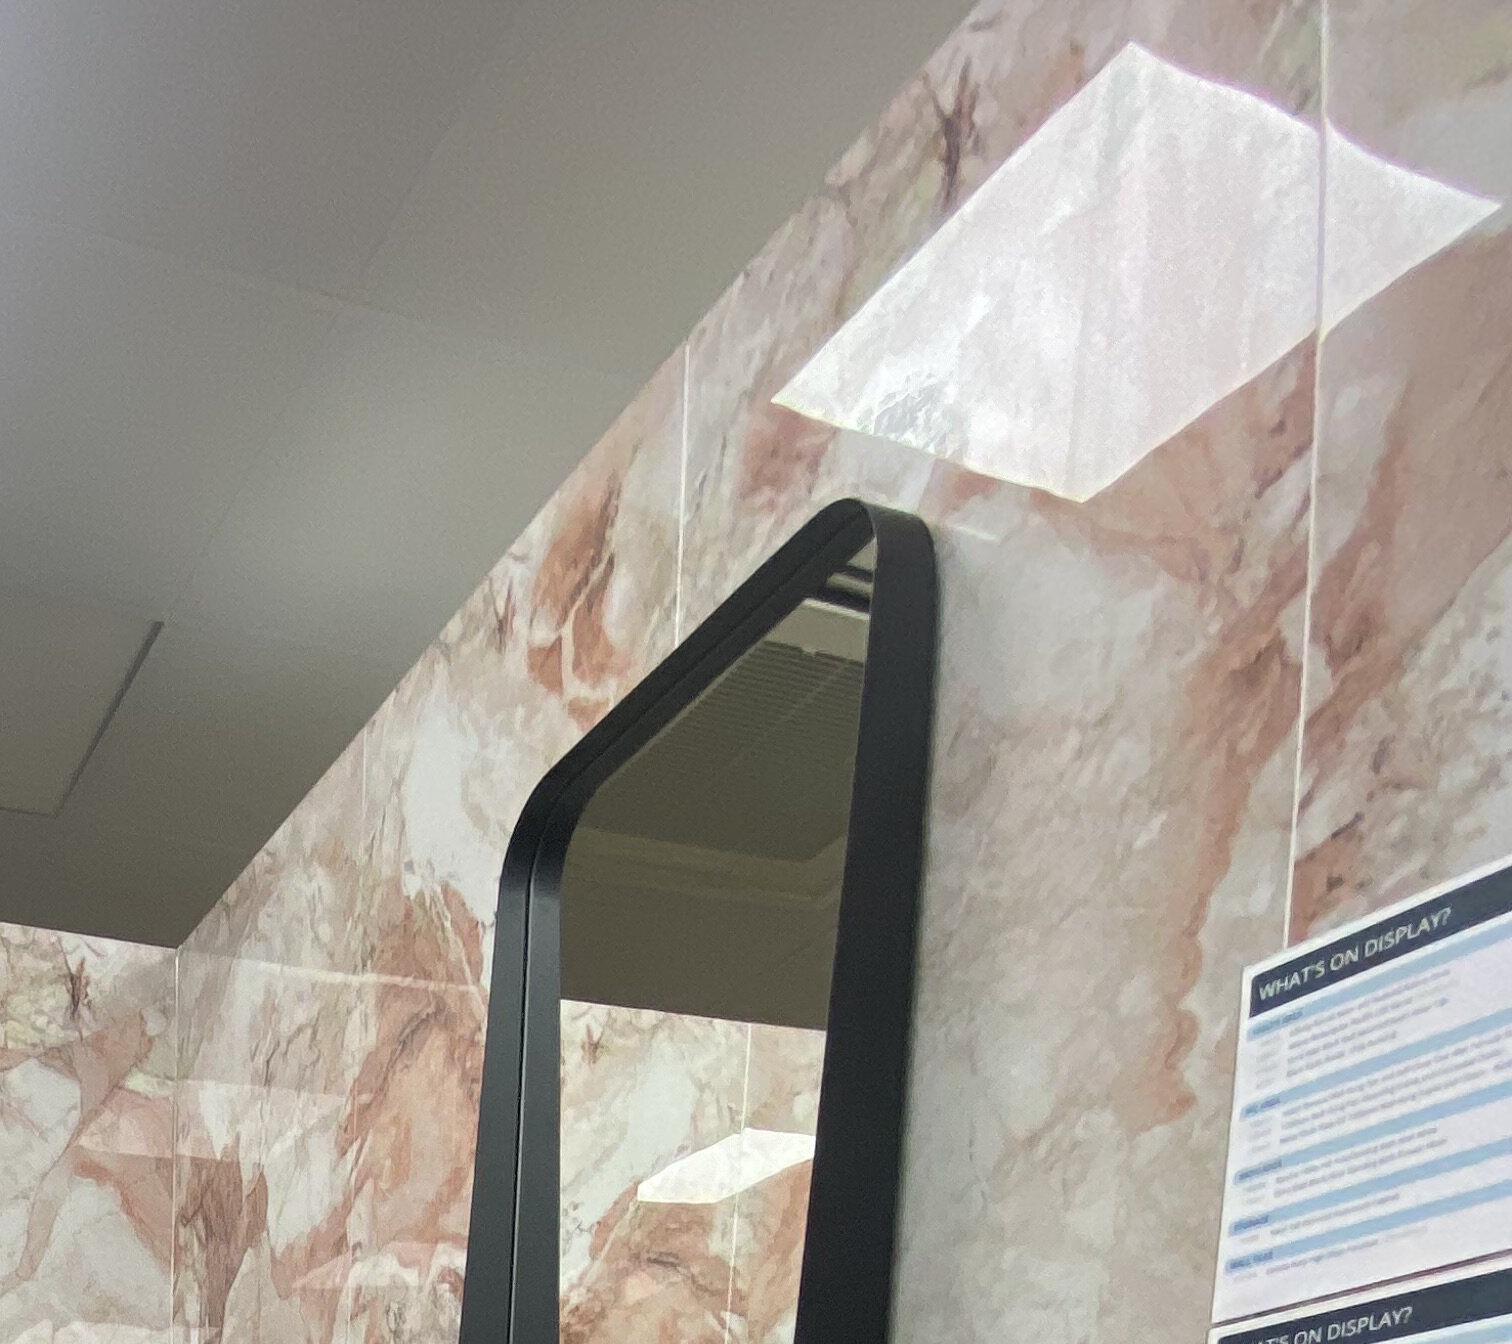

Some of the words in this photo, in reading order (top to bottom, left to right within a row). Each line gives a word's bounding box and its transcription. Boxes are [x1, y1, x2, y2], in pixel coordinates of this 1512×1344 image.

[1259, 959, 1325, 1001] WHAT'S
[1330, 946, 1359, 972] ON
[1363, 904, 1452, 959] DISPLAY?
[1327, 1306, 1413, 1342] DISPLAY?
